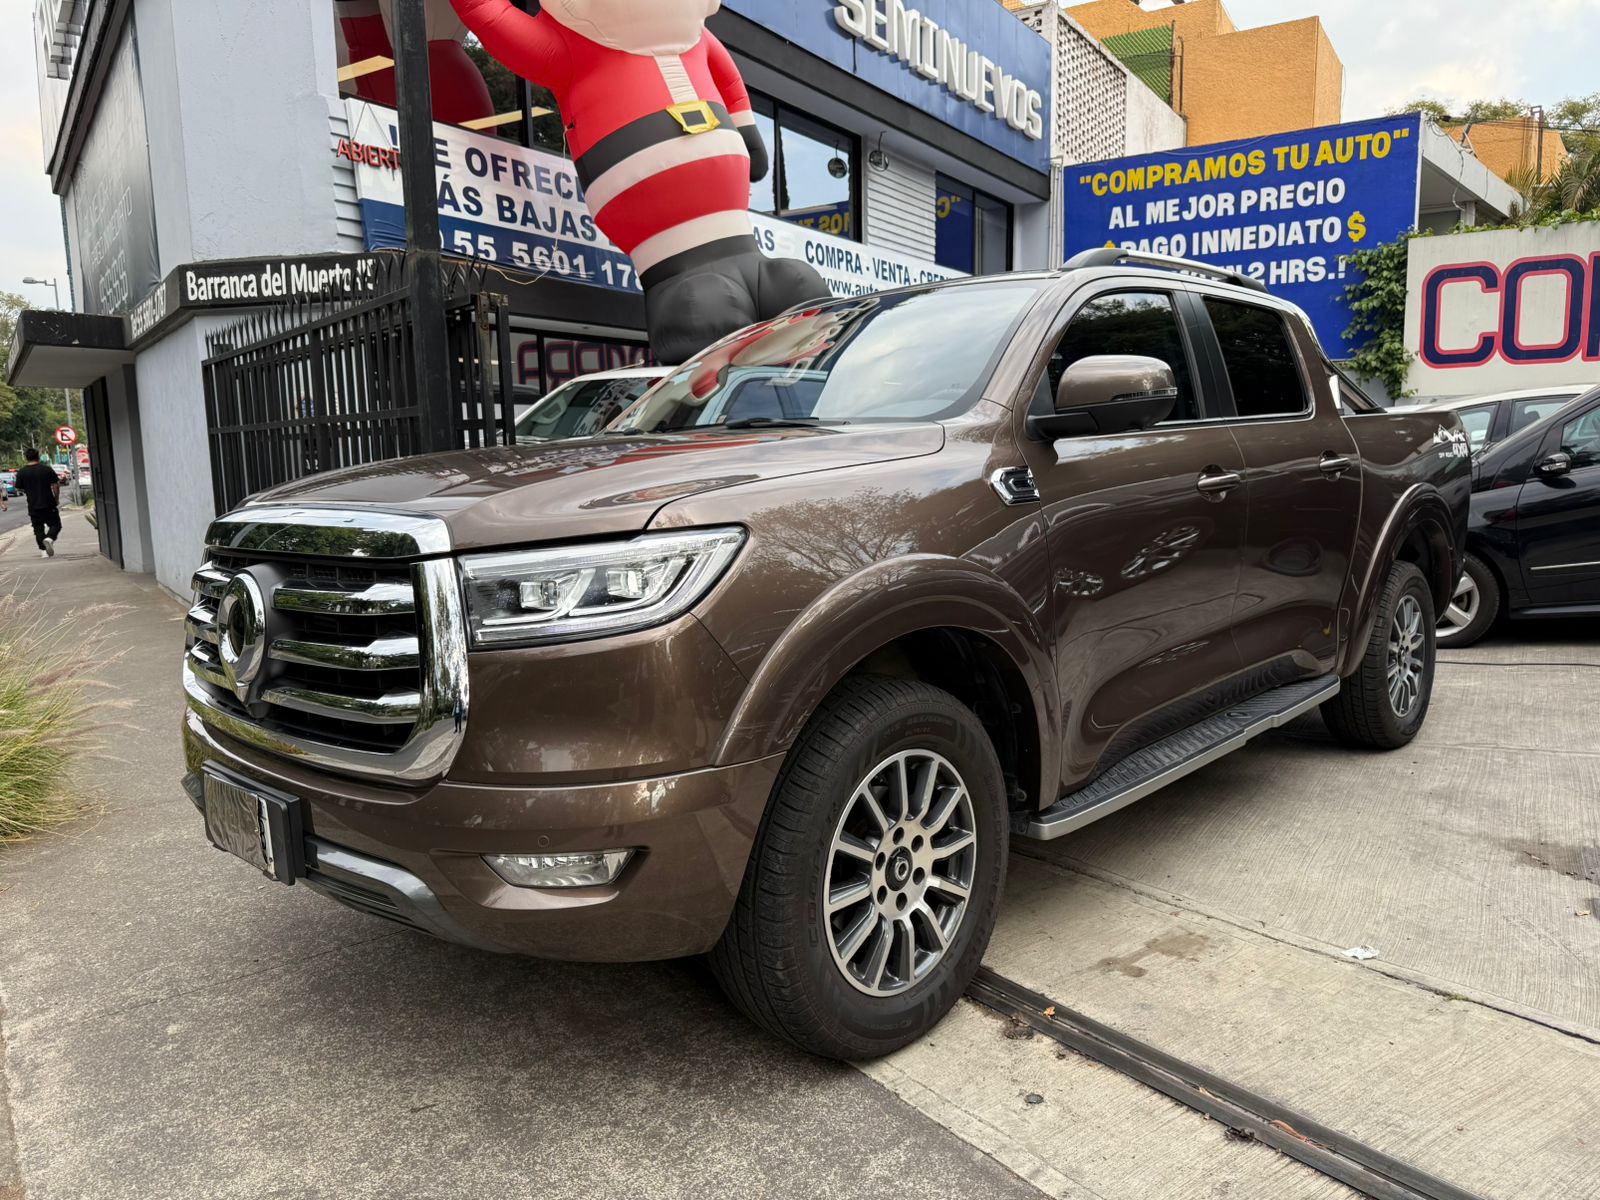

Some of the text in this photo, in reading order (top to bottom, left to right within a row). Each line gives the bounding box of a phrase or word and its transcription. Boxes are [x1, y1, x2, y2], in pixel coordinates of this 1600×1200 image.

[834, 0, 1042, 140] SEMINUEVOS
[336, 138, 401, 170] ABIERT
[1273, 143, 1309, 171] TU
[438, 174, 597, 242] ÁS BAJAS
[1109, 177, 1346, 229] AL MEJOR PRECIO
[453, 230, 497, 262] 55
[511, 241, 587, 278] 5601
[1192, 216, 1342, 256] INMEDIATO
[1347, 211, 1367, 242] $
[186, 270, 257, 301] Barranca
[261, 262, 287, 296] del
[805, 240, 863, 275] COMPRA
[872, 257, 911, 286] VENTA
